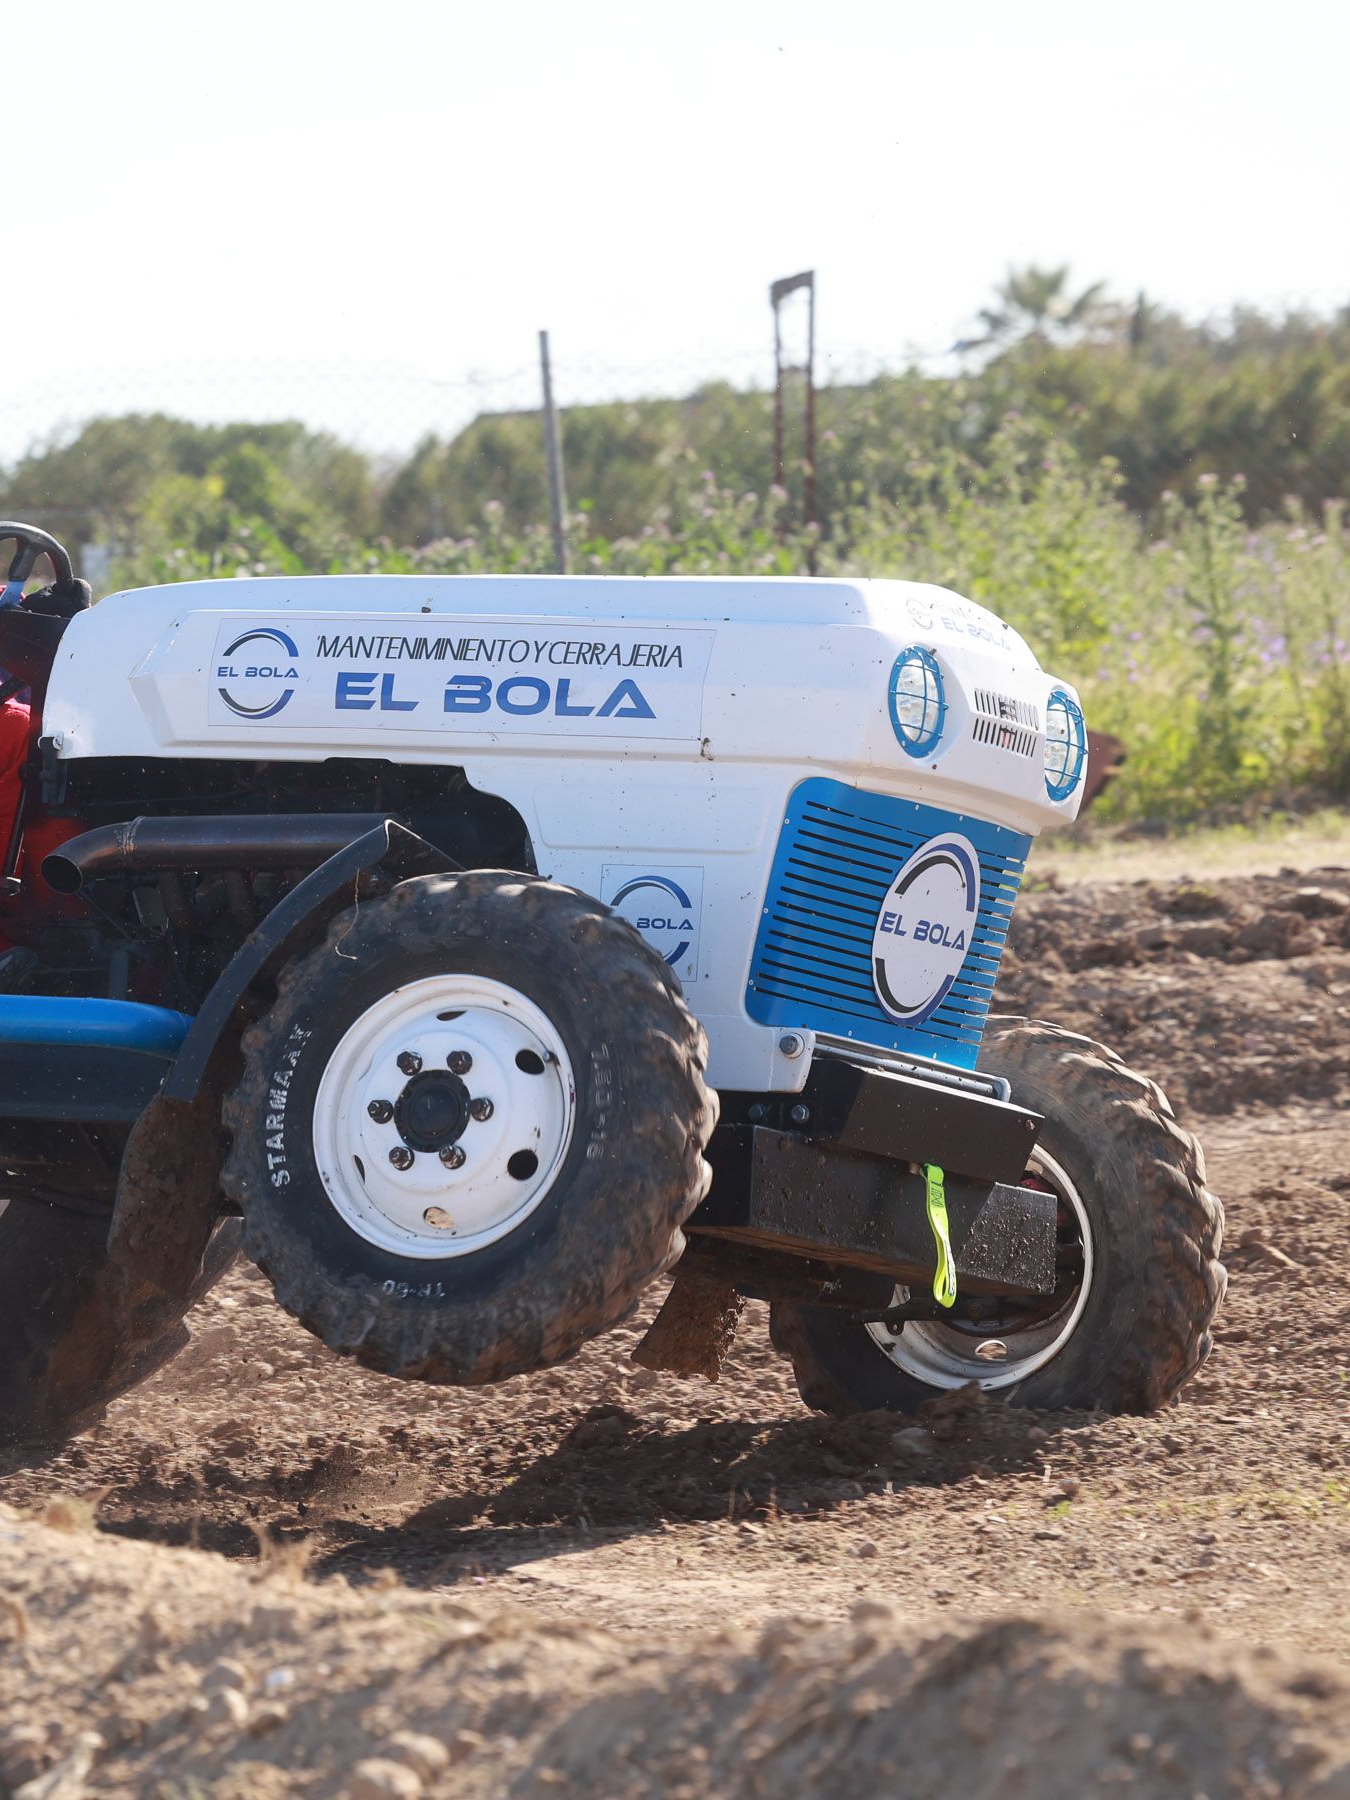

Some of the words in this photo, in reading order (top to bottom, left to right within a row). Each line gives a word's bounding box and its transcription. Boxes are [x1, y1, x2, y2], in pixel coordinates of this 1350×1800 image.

[548, 641, 684, 668] CERRAJERIA
[218, 666, 239, 677] EL
[245, 666, 299, 678] BOLA
[335, 672, 419, 711] EL
[443, 675, 657, 719] BOLA
[636, 917, 694, 930] BOLA
[879, 910, 907, 936] EL
[913, 919, 965, 951] BOLA
